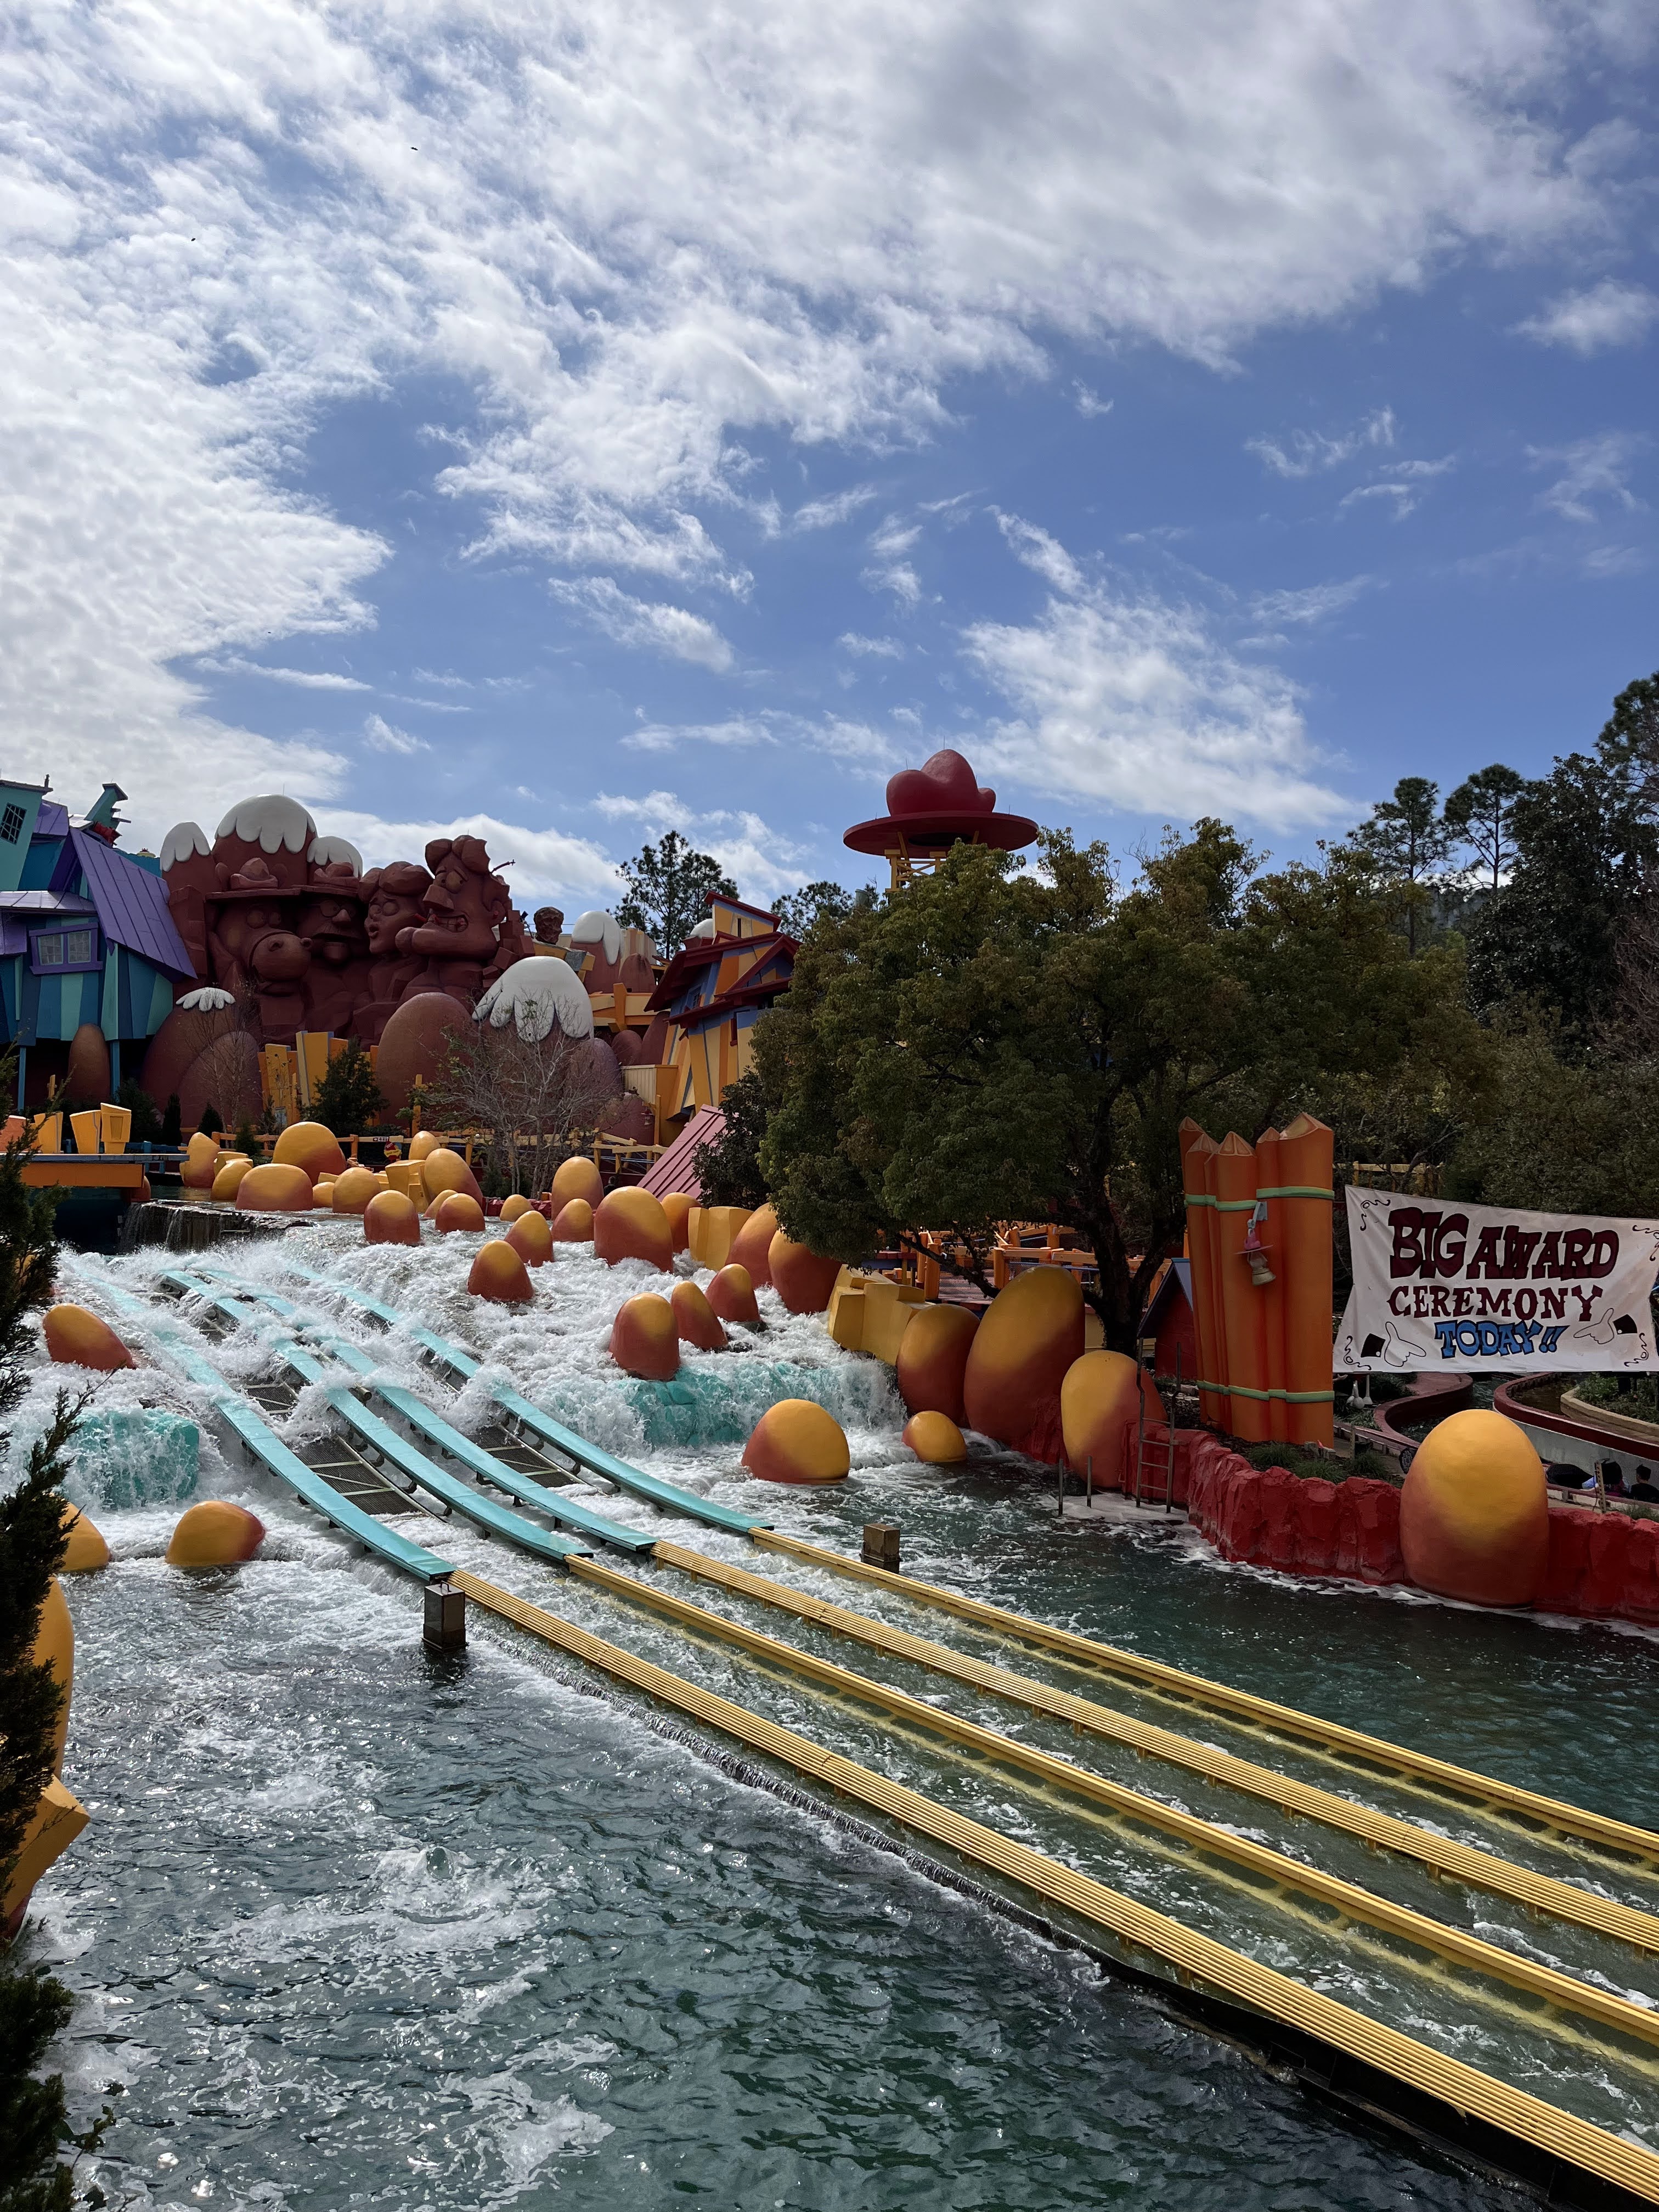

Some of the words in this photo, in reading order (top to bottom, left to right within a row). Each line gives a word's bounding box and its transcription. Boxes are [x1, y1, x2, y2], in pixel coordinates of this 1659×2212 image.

[1388, 1206, 1469, 1279] BIG
[1466, 1225, 1620, 1280] AWARD
[1387, 1285, 1603, 1322] CEREMONY
[1435, 1319, 1570, 1359] TODAY!!
